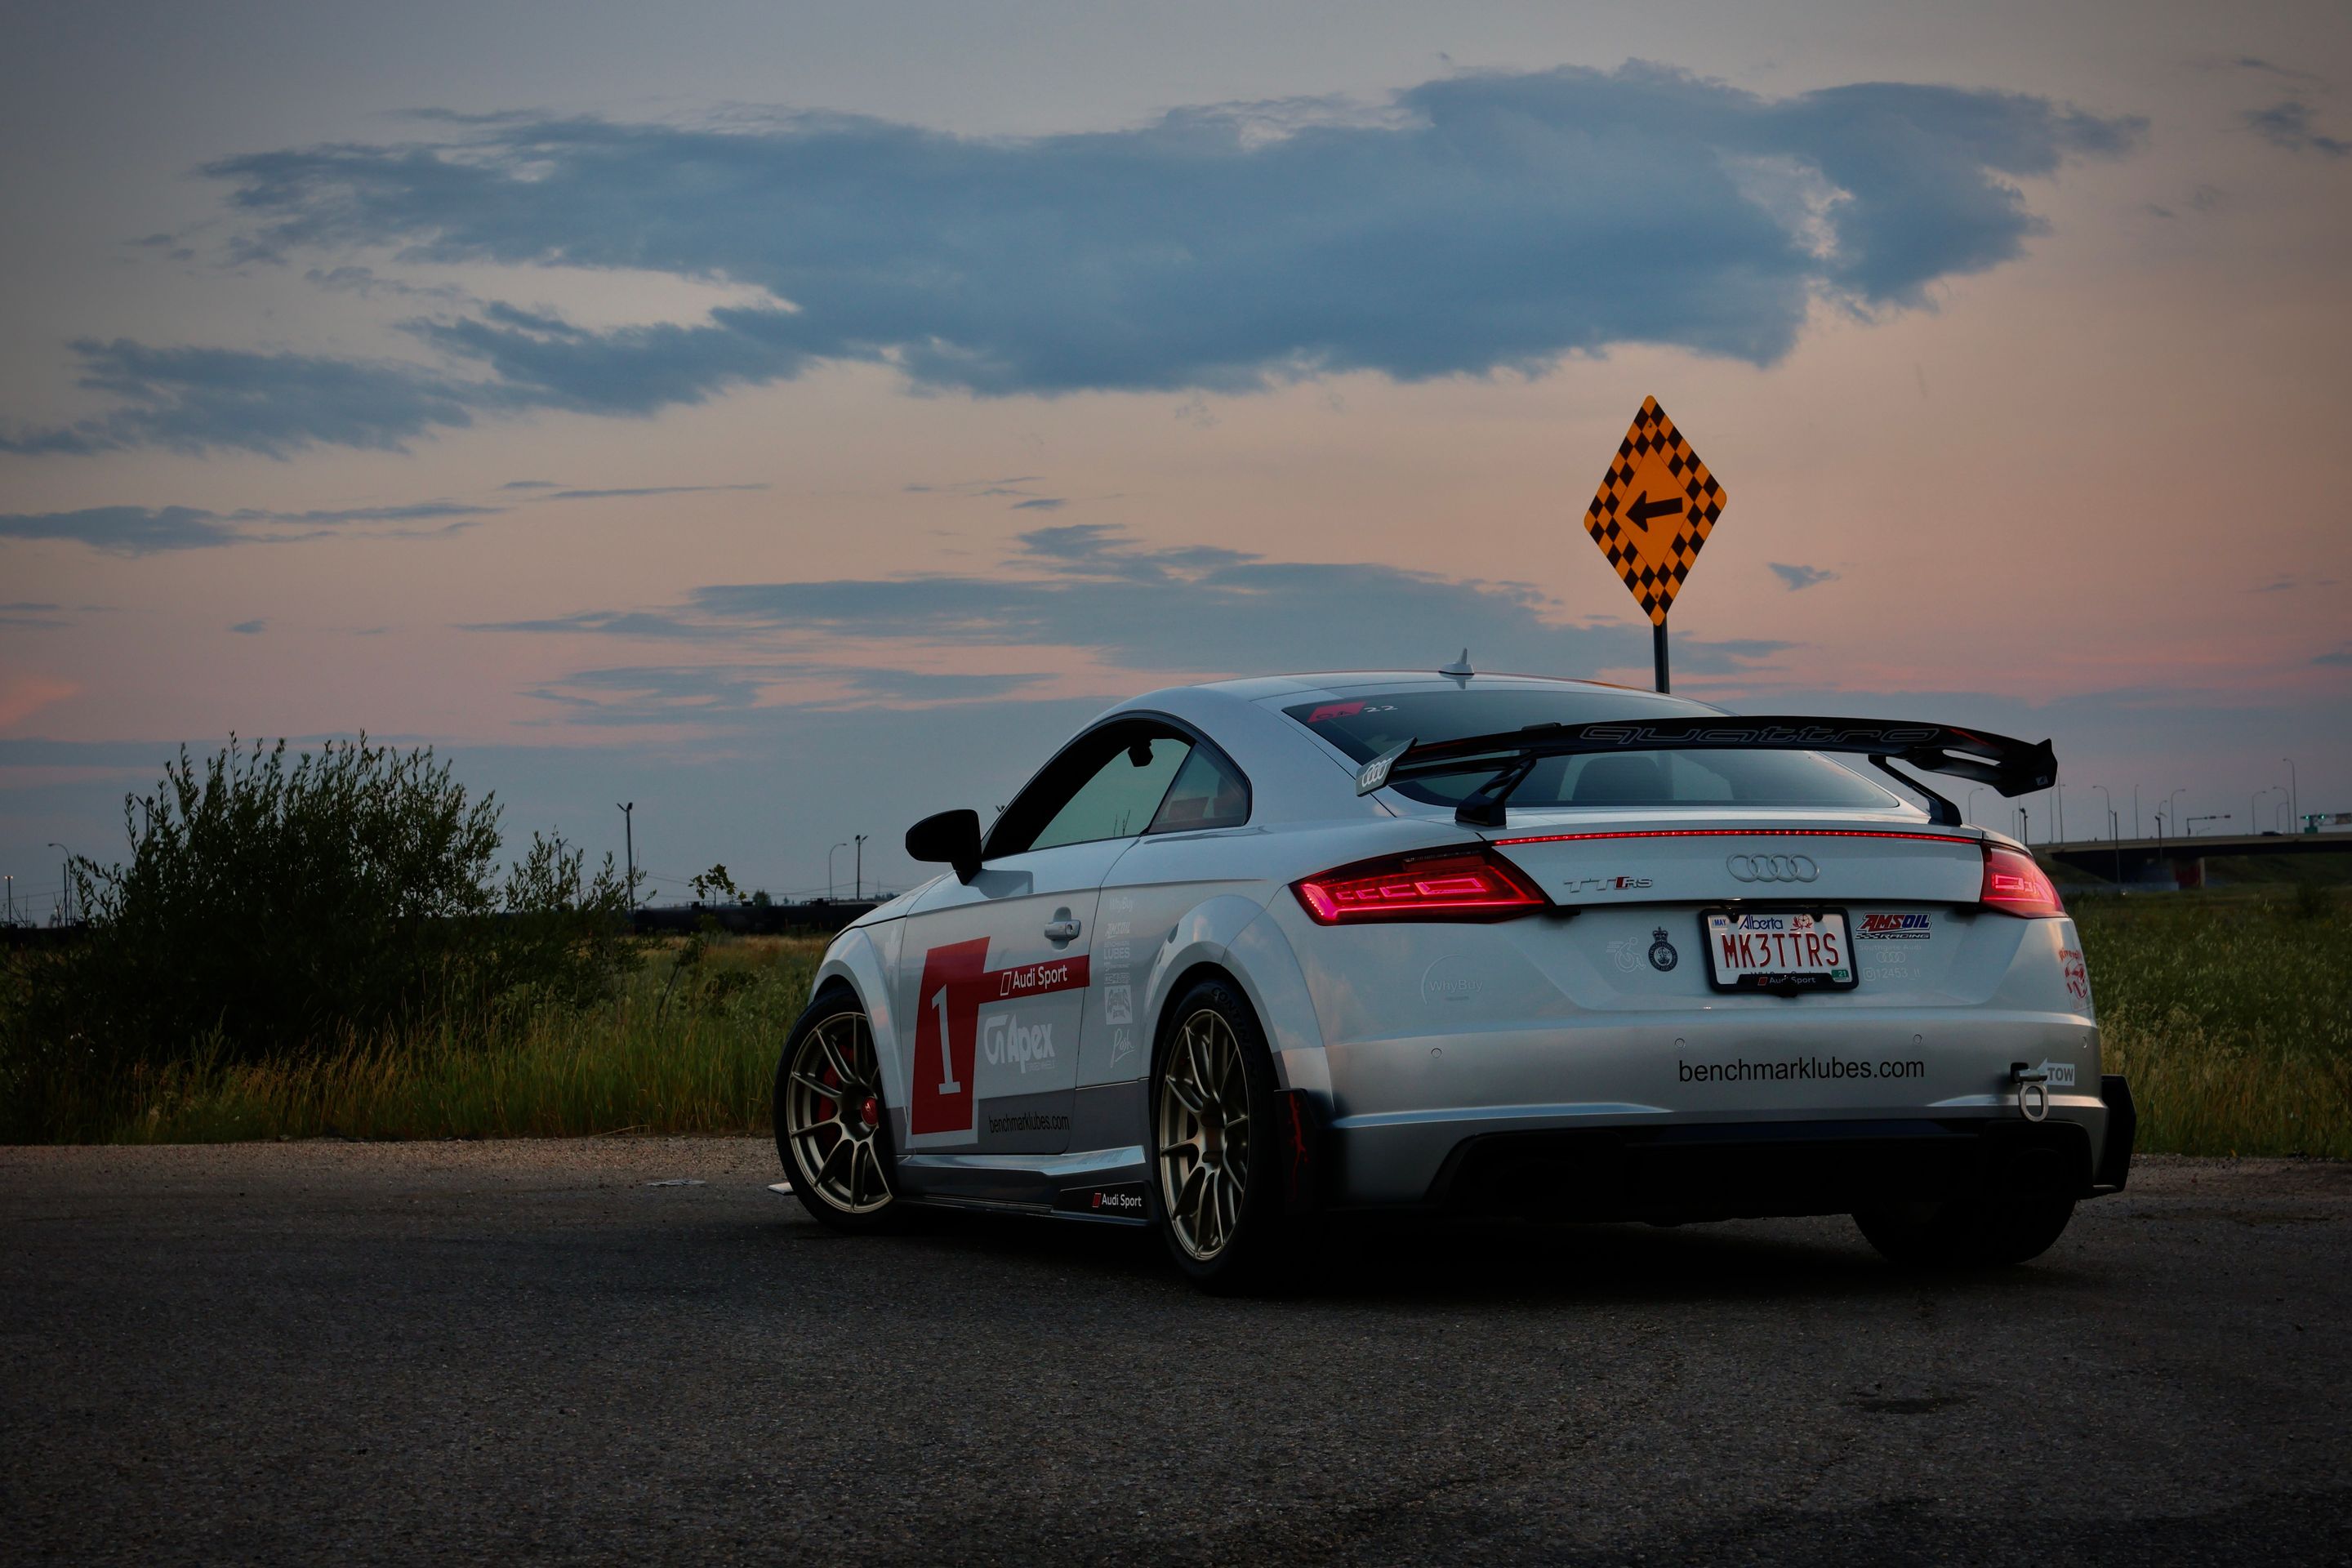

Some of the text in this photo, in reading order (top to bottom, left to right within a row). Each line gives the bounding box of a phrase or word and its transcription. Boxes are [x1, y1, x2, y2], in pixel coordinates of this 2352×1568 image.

[1579, 724, 1940, 744] quattro
[1739, 914, 1784, 930] Alberta
[1860, 914, 1930, 932] AMSOIL
[1104, 947, 1130, 960] LUBES
[1722, 933, 1839, 968] MK3TTRS
[1013, 964, 1068, 989] Audi Sport
[1769, 975, 1816, 985] Au Sport
[1429, 979, 1483, 994] WhyBuy
[932, 983, 961, 1094] 1
[1679, 1057, 1925, 1081] benchmarklubes.com
[2047, 1067, 2074, 1082] TOW
[988, 1111, 1070, 1133] benchmarklubes.com
[1102, 1192, 1143, 1209] Audi Sport
